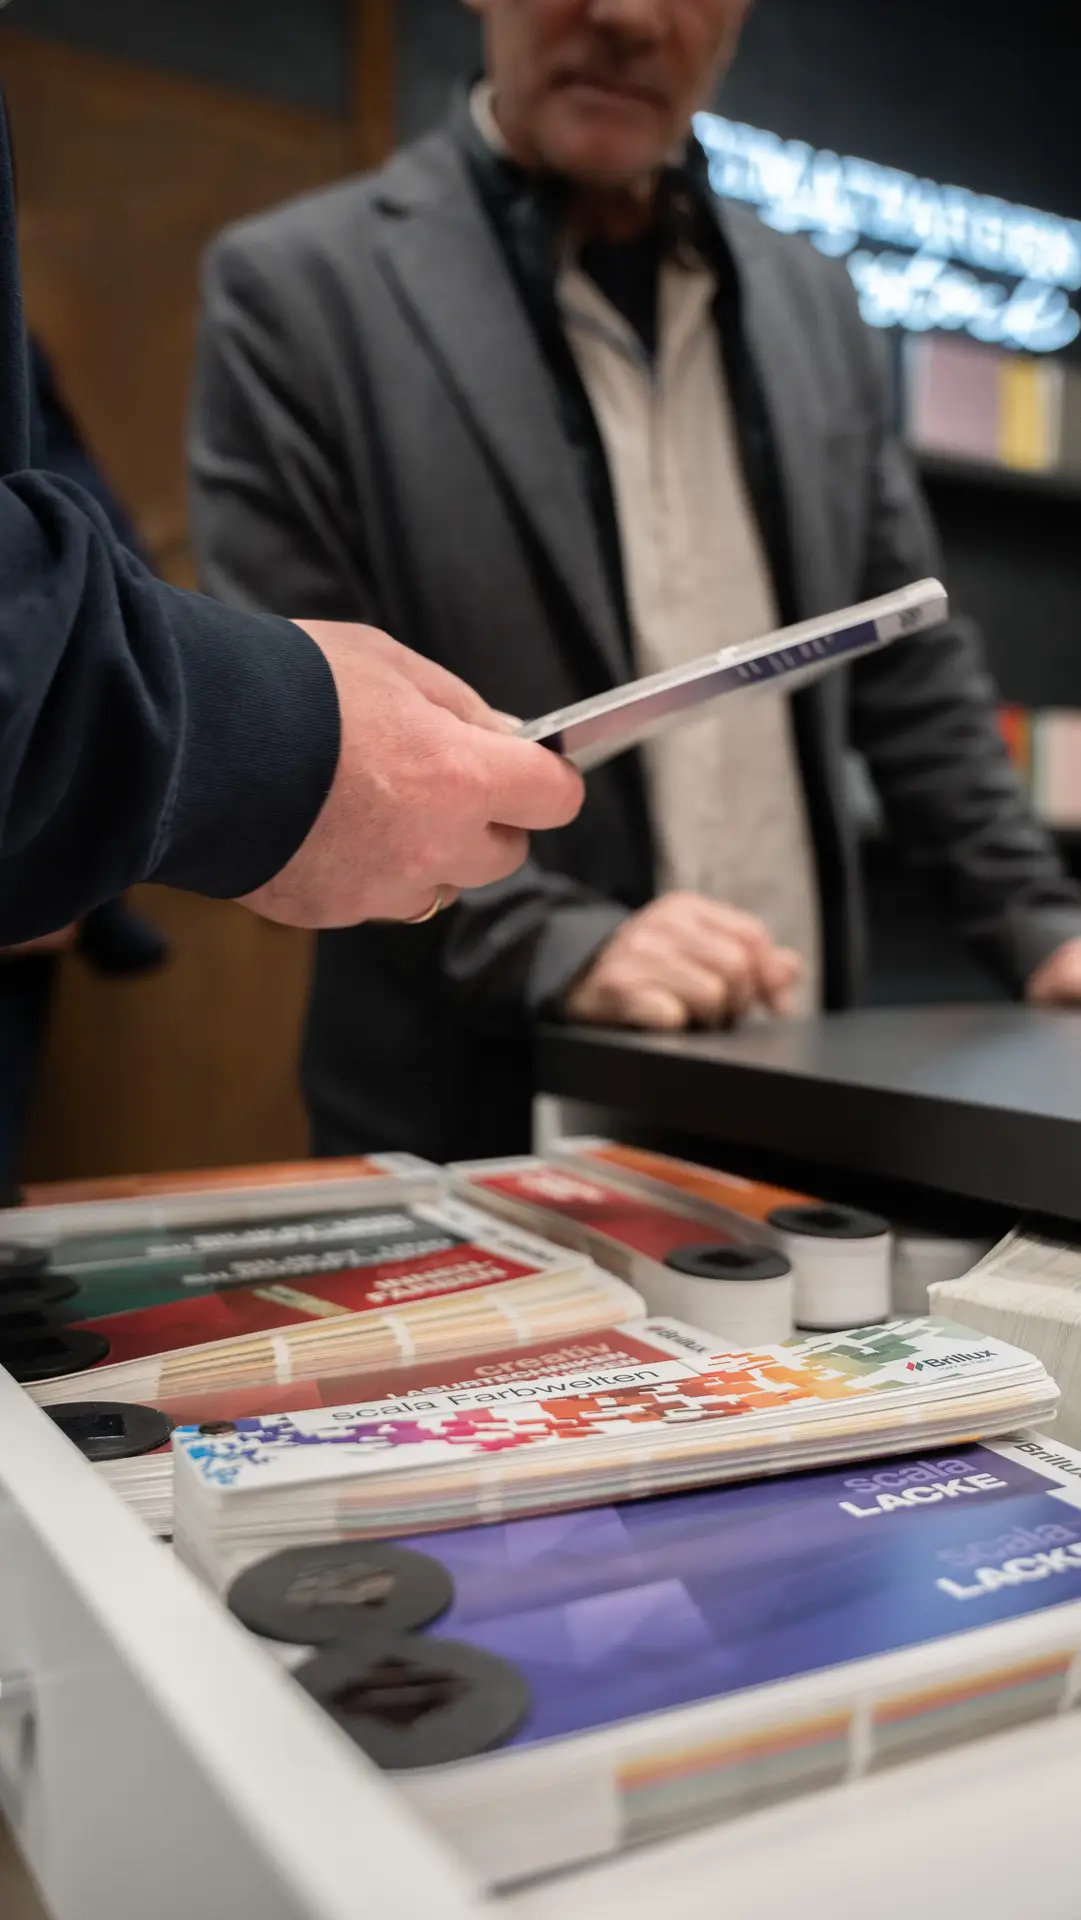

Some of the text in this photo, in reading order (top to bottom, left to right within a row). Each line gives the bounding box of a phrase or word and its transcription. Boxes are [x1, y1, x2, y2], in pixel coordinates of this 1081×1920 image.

[474, 1342, 611, 1377] creativ
[922, 1350, 998, 1368] Brillux
[331, 1368, 659, 1421] scala Farbwelten
[843, 1459, 977, 1494] scala
[1013, 1442, 1081, 1478] Brillu
[838, 1473, 1009, 1518] LACKE
